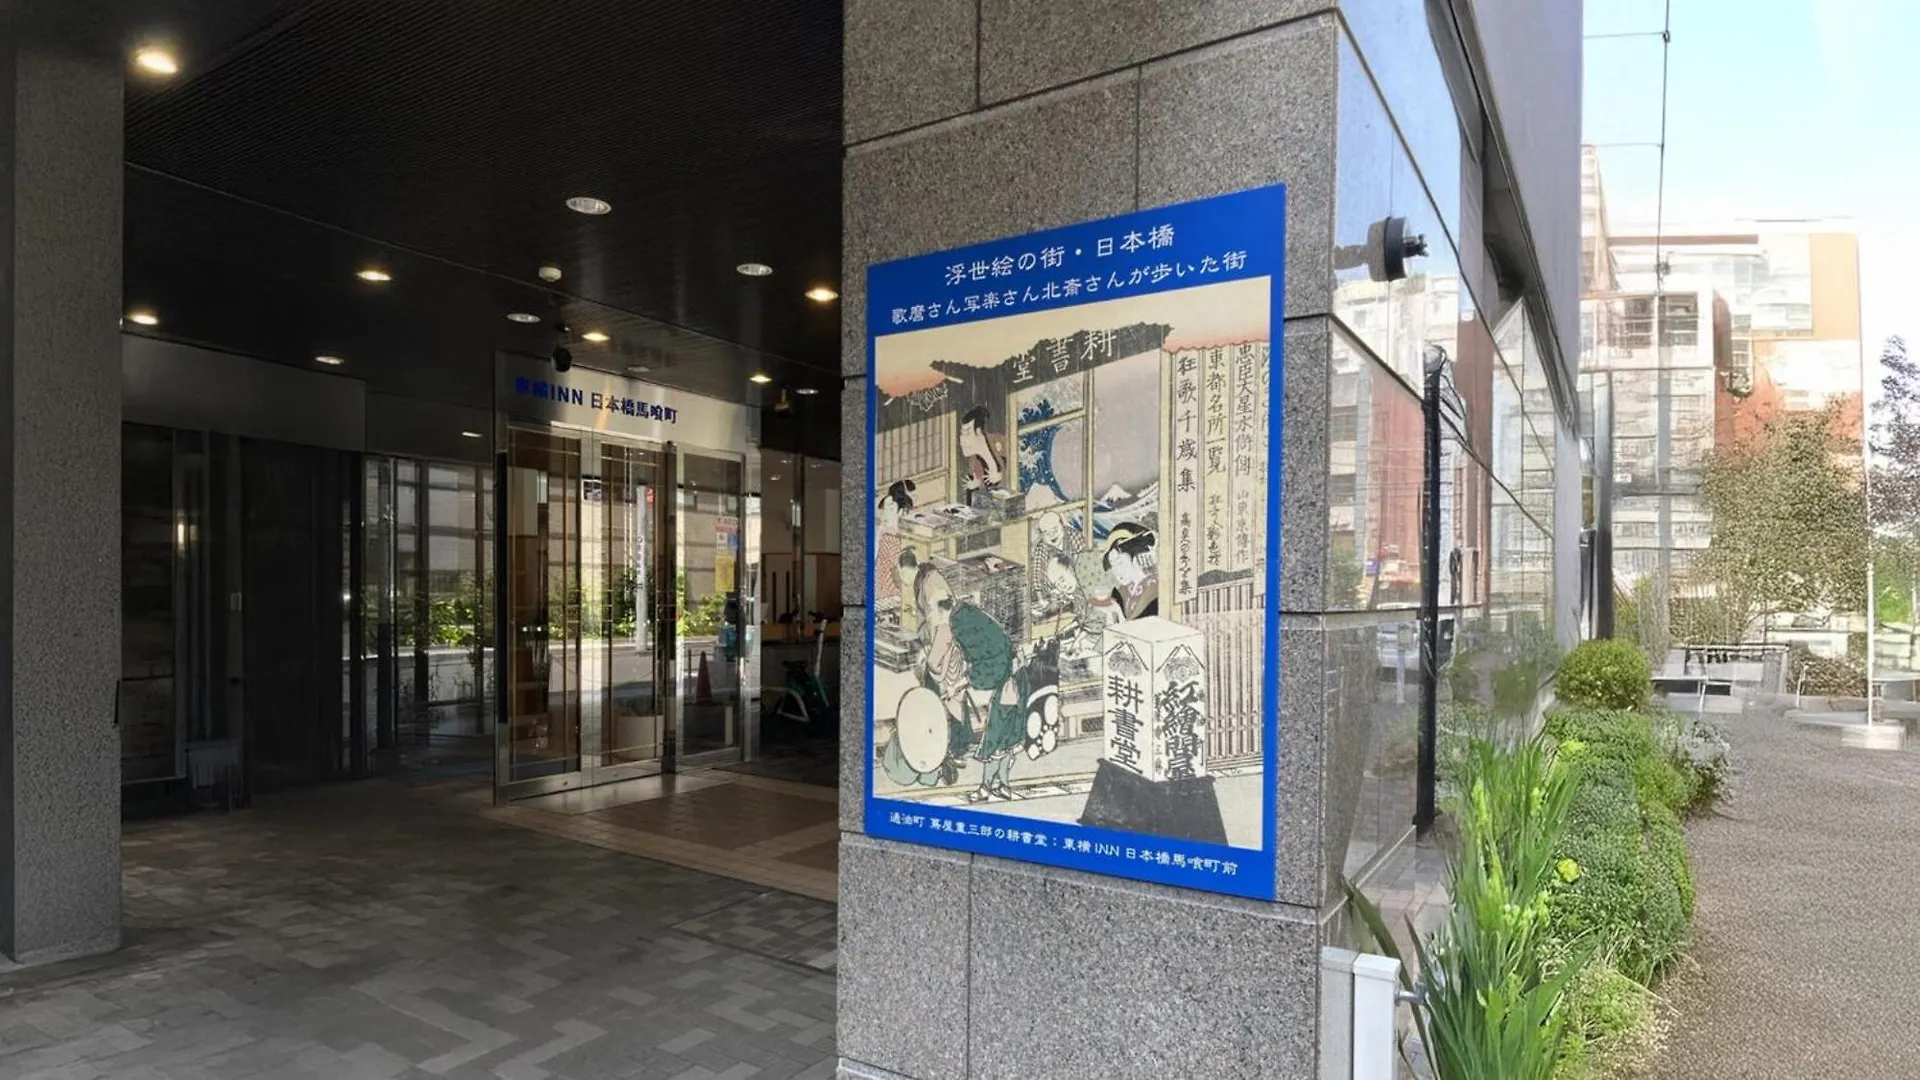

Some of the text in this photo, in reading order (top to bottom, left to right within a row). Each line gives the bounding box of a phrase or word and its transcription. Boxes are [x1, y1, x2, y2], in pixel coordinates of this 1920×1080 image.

[944, 223, 1176, 287] 浮世絵の街・日本橋
